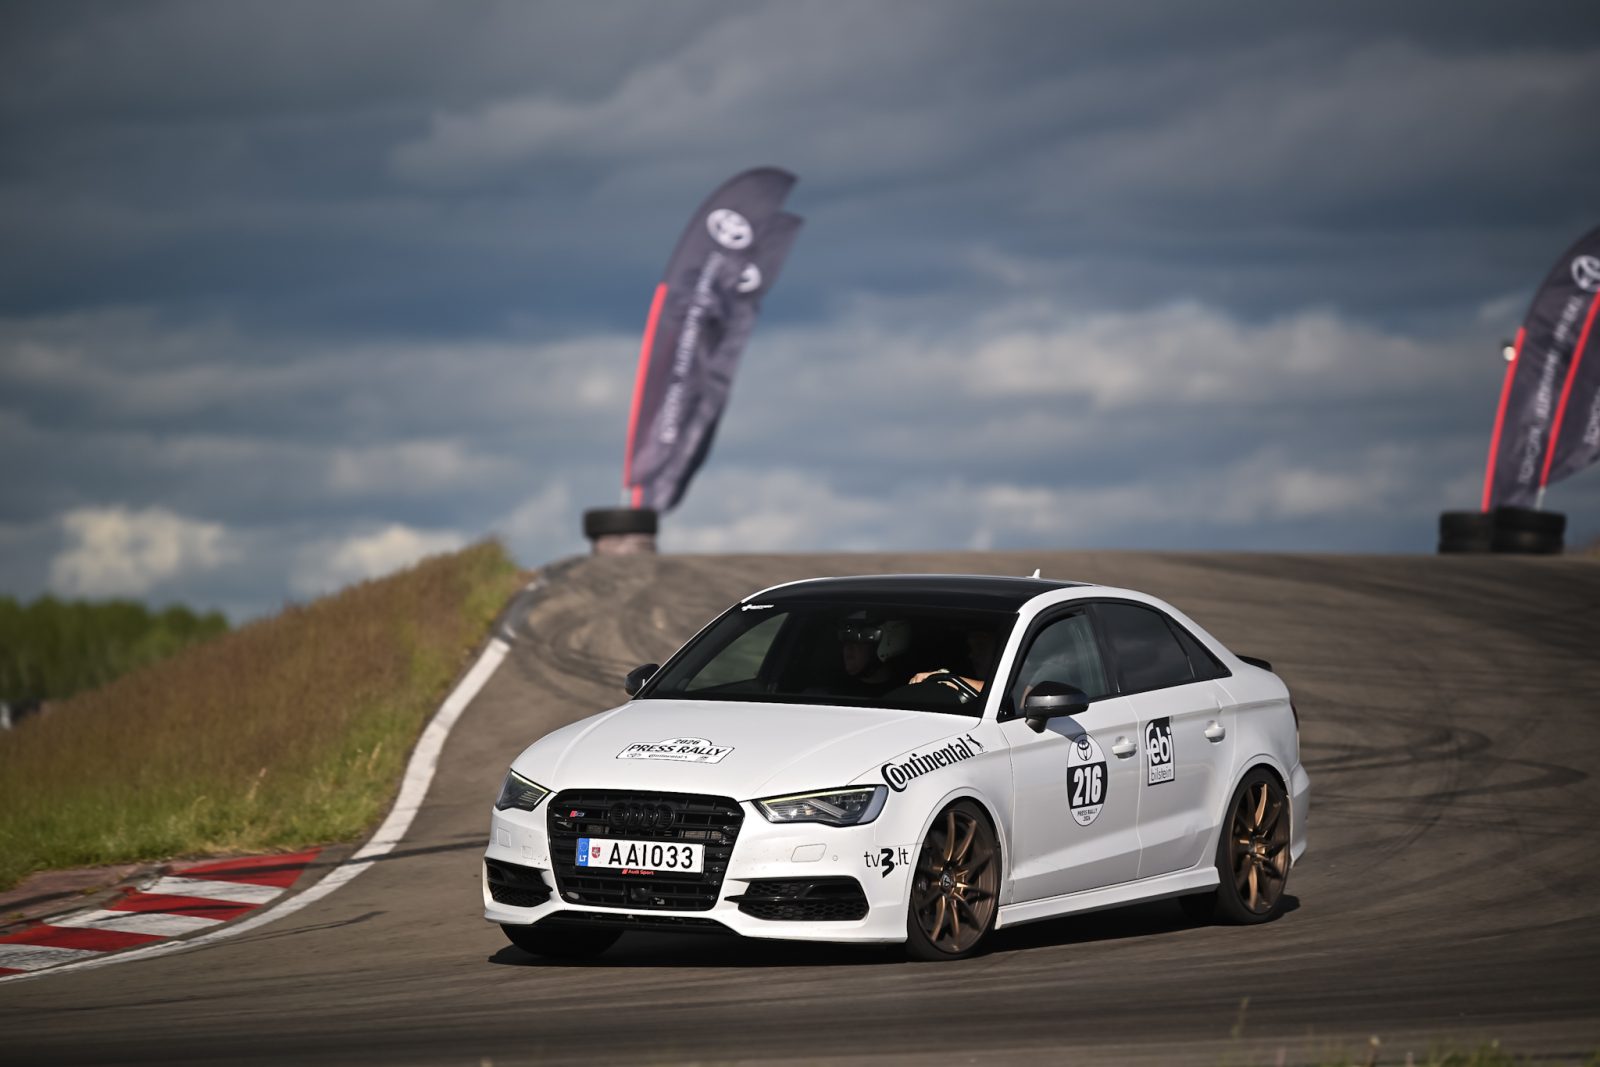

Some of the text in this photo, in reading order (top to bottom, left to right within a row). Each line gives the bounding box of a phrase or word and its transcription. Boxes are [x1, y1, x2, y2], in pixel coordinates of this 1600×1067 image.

[628, 744, 727, 756] PRESS RALLY
[1145, 721, 1172, 765] febi
[881, 737, 975, 793] Continental
[1151, 768, 1172, 782] bilstein
[1072, 765, 1102, 807] 216
[864, 847, 909, 879] tv3.lt
